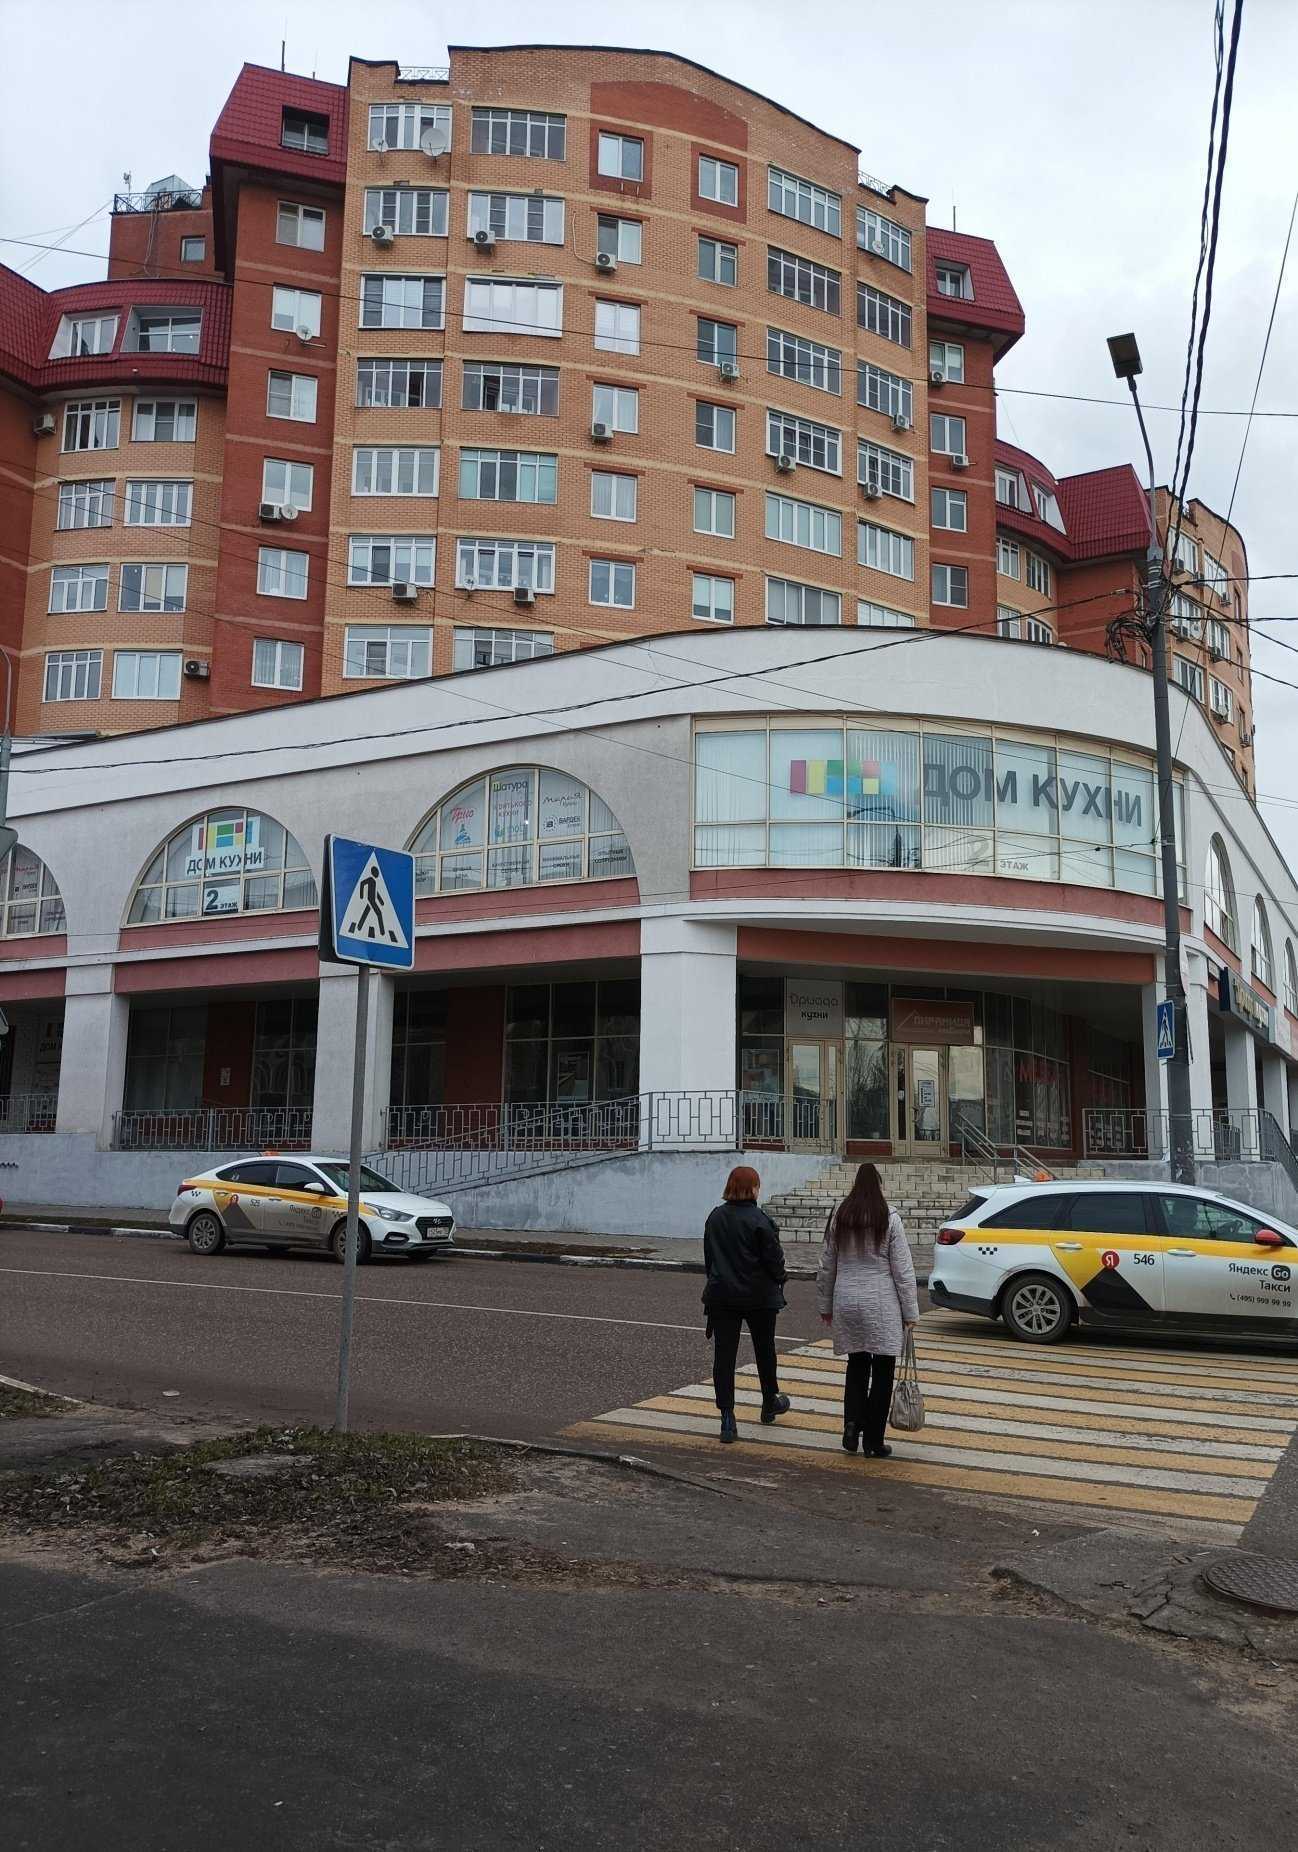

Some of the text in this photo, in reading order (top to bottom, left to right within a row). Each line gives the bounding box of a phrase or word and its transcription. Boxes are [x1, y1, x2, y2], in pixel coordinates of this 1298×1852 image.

[493, 780, 529, 792] Шатура
[924, 763, 1142, 827] ДОМ КУХНИ
[186, 851, 262, 875] ДОМ КУХНИ
[206, 889, 219, 911] 2
[801, 1010, 829, 1021] кухни
[1133, 1253, 1155, 1266] 546
[1228, 1262, 1290, 1279] Яндекс Go
[1259, 1279, 1291, 1293] Такси
